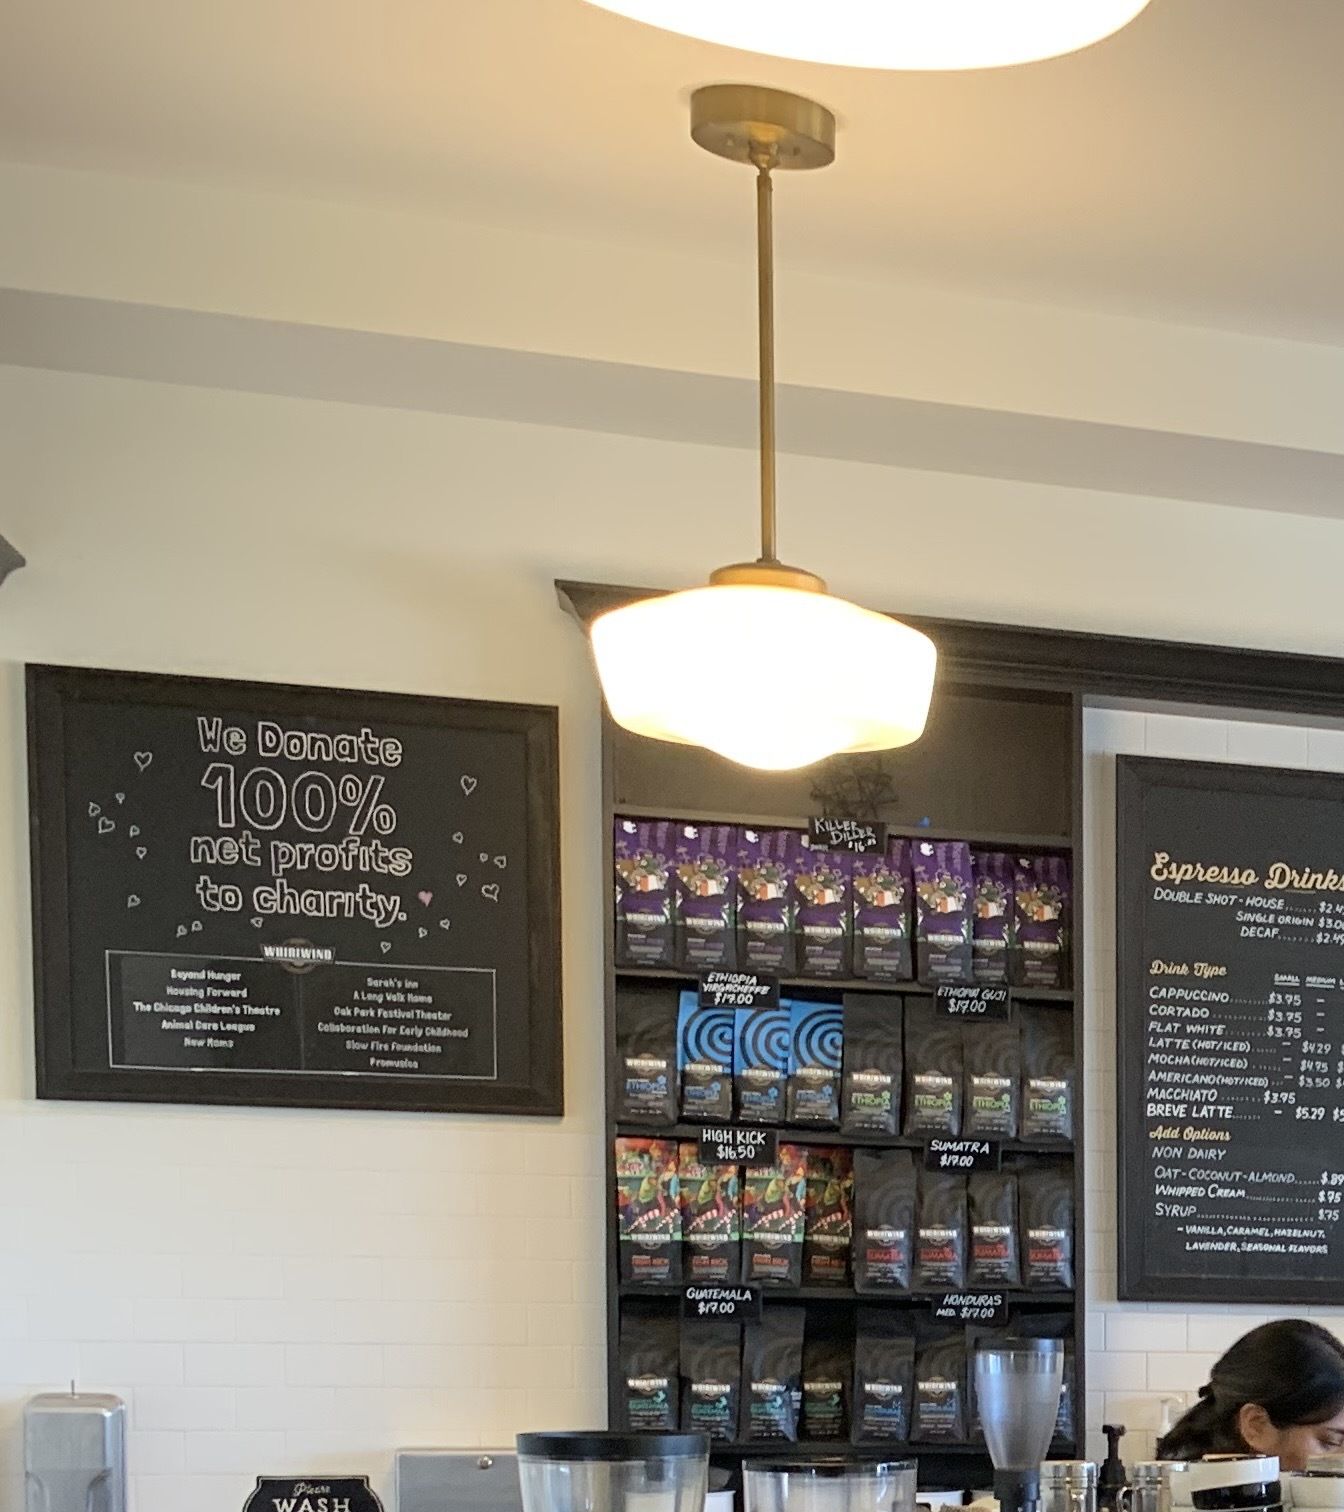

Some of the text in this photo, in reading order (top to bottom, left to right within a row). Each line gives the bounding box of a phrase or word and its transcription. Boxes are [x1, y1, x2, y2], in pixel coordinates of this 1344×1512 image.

[197, 717, 402, 767] We Donate
[201, 763, 396, 835] 100%
[191, 831, 412, 876] net profits
[1150, 852, 1259, 885] Espresso
[196, 876, 407, 927] to charity.
[1153, 887, 1203, 904] DOUBLE
[1205, 893, 1235, 905] SHOT
[1246, 896, 1285, 910] HOUSE
[1236, 911, 1275, 924] SINGLE
[1278, 915, 1315, 926] ORIGIN
[1241, 926, 1279, 938] DECAF
[1150, 960, 1227, 978] Drink Type
[1150, 986, 1229, 1003] CAPPUCCINO
[133, 1001, 151, 1012] The
[1149, 1004, 1210, 1019] CORTADO
[1148, 1021, 1181, 1034] FLAT
[1186, 1023, 1226, 1036] WHITE
[1147, 1088, 1218, 1101] MACCHIATO
[1147, 1103, 1187, 1118] BREVE
[1191, 1105, 1233, 1119] LATTE
[1295, 1106, 1325, 1120] $5.29
[702, 1129, 766, 1145] HIGH KICK
[1149, 1125, 1231, 1143] Add Options
[930, 1140, 990, 1154] SUMATRA
[1152, 1146, 1226, 1160] NON DAIRY
[686, 1287, 752, 1301] GUATEMALA
[943, 1294, 1003, 1307] HONDURAS
